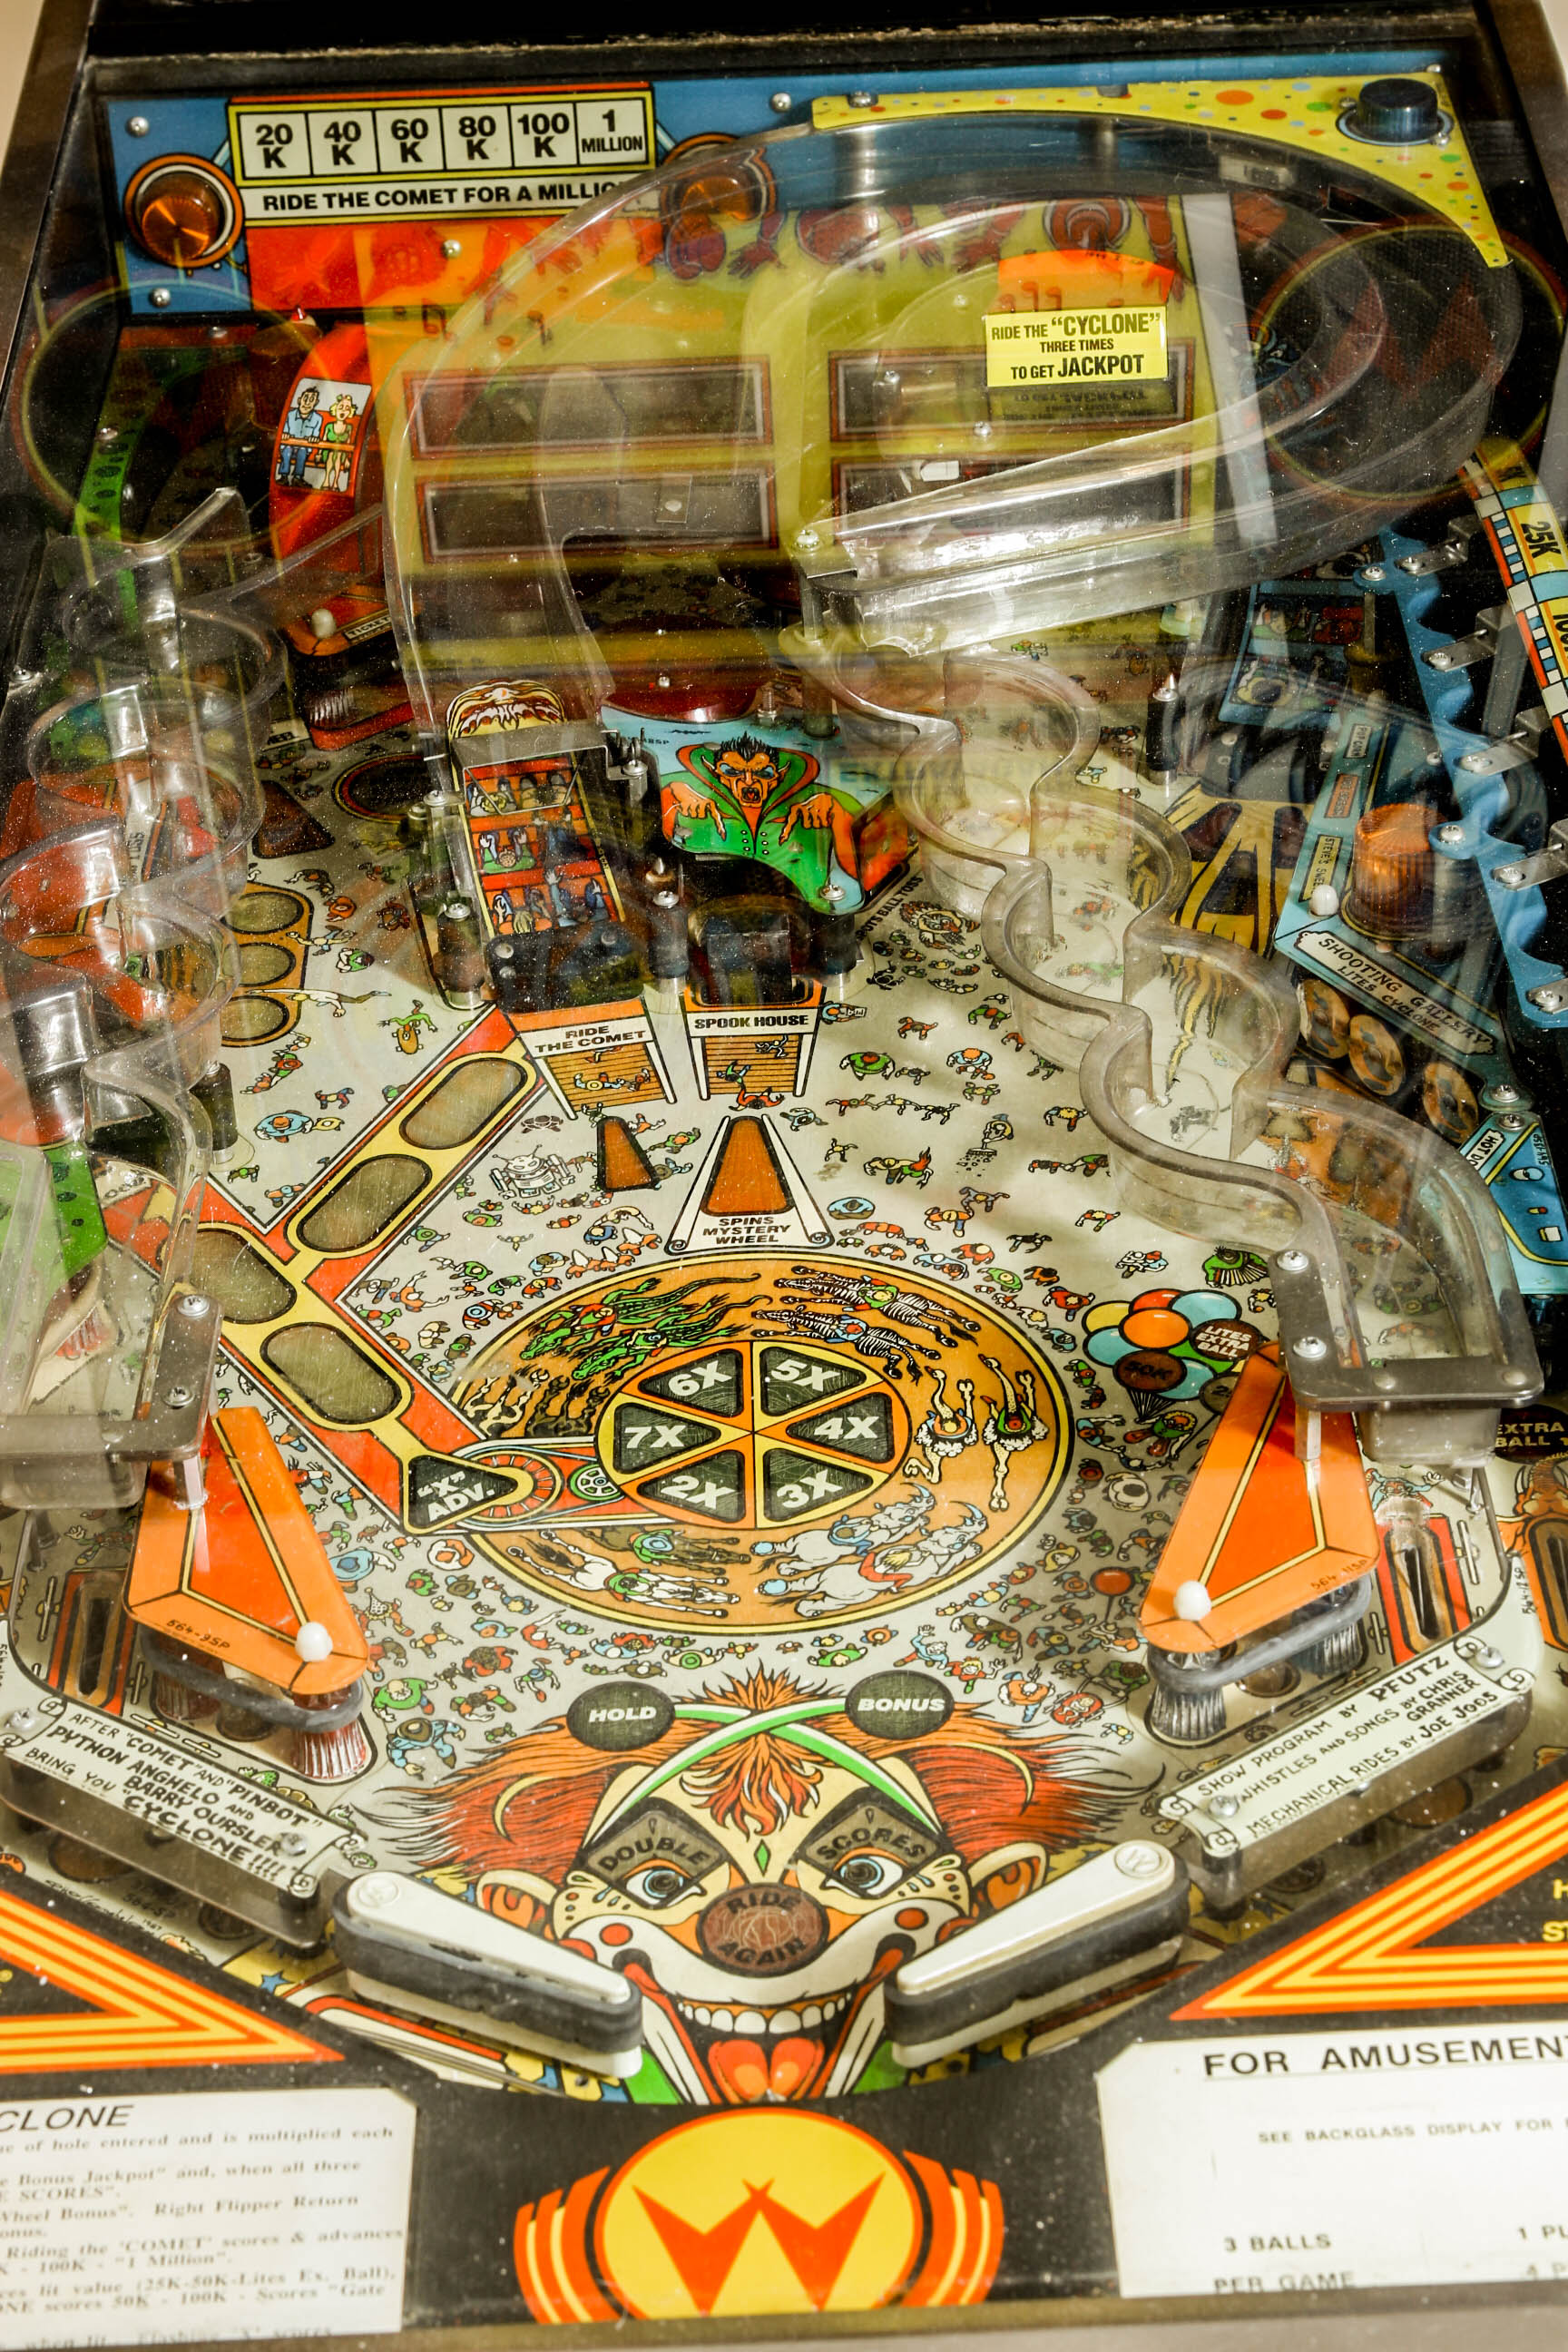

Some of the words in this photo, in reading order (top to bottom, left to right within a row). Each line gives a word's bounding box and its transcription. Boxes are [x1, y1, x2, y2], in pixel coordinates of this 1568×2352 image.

[323, 121, 362, 142] 40
[391, 118, 428, 140] 60
[458, 115, 496, 137] 80
[517, 113, 570, 135] 100
[602, 109, 615, 132] 1
[255, 123, 293, 145] 20
[582, 136, 643, 153] MILLION
[262, 146, 287, 169] K
[331, 143, 355, 166] K
[399, 142, 423, 163] K
[466, 138, 490, 161] K
[534, 136, 556, 158] K
[263, 194, 318, 211] RIDE
[322, 191, 370, 209] THE
[375, 188, 458, 207] COMET
[464, 186, 511, 203] FOR
[517, 185, 537, 201] A
[538, 181, 618, 201] MILLIO
[991, 325, 1021, 340] RIDE
[1024, 324, 1048, 338] THE
[1051, 312, 1161, 336] "CYCLONE"
[1040, 340, 1075, 354] THREE
[1080, 338, 1114, 351] TIMES
[1011, 366, 1027, 379] TO
[1031, 365, 1054, 378] GET
[1057, 354, 1144, 377] JACKPOT
[1521, 520, 1562, 559] 25K
[1318, 937, 1403, 992] SHOOTING
[1409, 996, 1491, 1044] GALLERY
[1338, 965, 1376, 991] LITES
[1381, 995, 1441, 1032] CYCLONE
[564, 1024, 610, 1039] RIDE
[694, 1016, 750, 1029] SPOOK
[753, 1014, 809, 1027] HOUSE
[534, 1041, 575, 1054] THE
[577, 1029, 647, 1046] COMET
[1477, 1136, 1499, 1154] HOT
[1470, 1152, 1485, 1167] DO
[701, 1224, 792, 1237] MYSTERY
[719, 1215, 775, 1226] SPINS
[715, 1233, 779, 1245] WHEEL
[1195, 1332, 1250, 1351] EXTRA
[1204, 1326, 1252, 1342] LITES
[1197, 1341, 1239, 1357] BALL
[668, 1359, 732, 1396] 6X
[771, 1359, 841, 1392] 5X
[1124, 1361, 1173, 1380] 50K
[624, 1425, 687, 1449] 7X
[814, 1416, 880, 1440] 4X
[1495, 1436, 1551, 1447] BALL
[417, 1471, 466, 1498] "X"
[660, 1475, 736, 1510] 2X
[776, 1470, 844, 1508] 3X
[427, 1482, 495, 1523] ADV.
[857, 1697, 946, 1713] BONUS
[1406, 1678, 1481, 1722] GRANNER
[588, 1706, 657, 1723] HOLD
[1197, 1764, 1246, 1797] SHOW
[1252, 1720, 1332, 1769] PROGRAM
[1338, 1703, 1358, 1720] BY
[1368, 1655, 1450, 1702] PFUTZ
[1240, 1754, 1318, 1803] WHISTLES
[1318, 1738, 1346, 1755] AND
[1347, 1709, 1400, 1742] SONGS
[1402, 1696, 1418, 1710] BY
[1418, 1670, 1470, 1700] CHRIS
[24, 1748, 76, 1777] BRING
[85, 1772, 116, 1793] YOU
[46, 1725, 129, 1765] PYTHON
[127, 1760, 220, 1805] ANGHELO
[227, 1803, 255, 1821] AND
[68, 1712, 121, 1740] AFTER
[126, 1732, 203, 1772] "COMET"
[193, 1769, 225, 1788] AND
[226, 1778, 323, 1828] "PINBOT"
[1245, 1773, 1356, 1838] MECHANICAL
[1352, 1747, 1400, 1779] RIDES
[1399, 1735, 1418, 1749] BY
[1419, 1716, 1451, 1740] JOE
[1455, 1690, 1499, 1719] JOOS
[123, 1776, 193, 1809] BARRY
[193, 1807, 282, 1856] OURSLER
[597, 1837, 710, 1872] DOUBLE
[818, 1826, 926, 1860] SCORES
[726, 1889, 803, 1914] RIDE
[715, 1935, 808, 1965] AGAIN
[1203, 2051, 1290, 2077] FOR
[24, 2140, 43, 2152] of
[52, 2139, 90, 2151] hole
[101, 2135, 169, 2149] entered
[179, 2132, 213, 2145] and
[224, 2132, 237, 2142] is
[248, 2128, 342, 2143] multiplied
[352, 2128, 394, 2140] each
[1258, 2131, 1292, 2144] SEE
[1305, 2124, 1416, 2141] BACKGLASS
[1427, 2120, 1502, 2136] DISPLAY
[1514, 2118, 1553, 2132] FOR
[19, 2173, 74, 2186] Bonus
[226, 2163, 273, 2176] when
[282, 2161, 304, 2173] all
[314, 2161, 361, 2173] three
[154, 2202, 203, 2218] Right
[215, 2199, 281, 2213] Flipper
[293, 2196, 359, 2209] Return
[6, 2246, 69, 2259] Riding
[79, 2243, 109, 2255] the
[221, 2235, 279, 2247] scores
[290, 2231, 304, 2243] &
[318, 2229, 404, 2242] advances
[1224, 2237, 1237, 2252] 3
[1250, 2233, 1331, 2252] BALLS
[39, 2283, 59, 2297] lit
[74, 2281, 122, 2294] value
[1214, 2276, 1264, 2293] PER
[1279, 2271, 1356, 2291] GAME
[44, 2300, 103, 2312] scores
[257, 2288, 318, 2300] Scores
